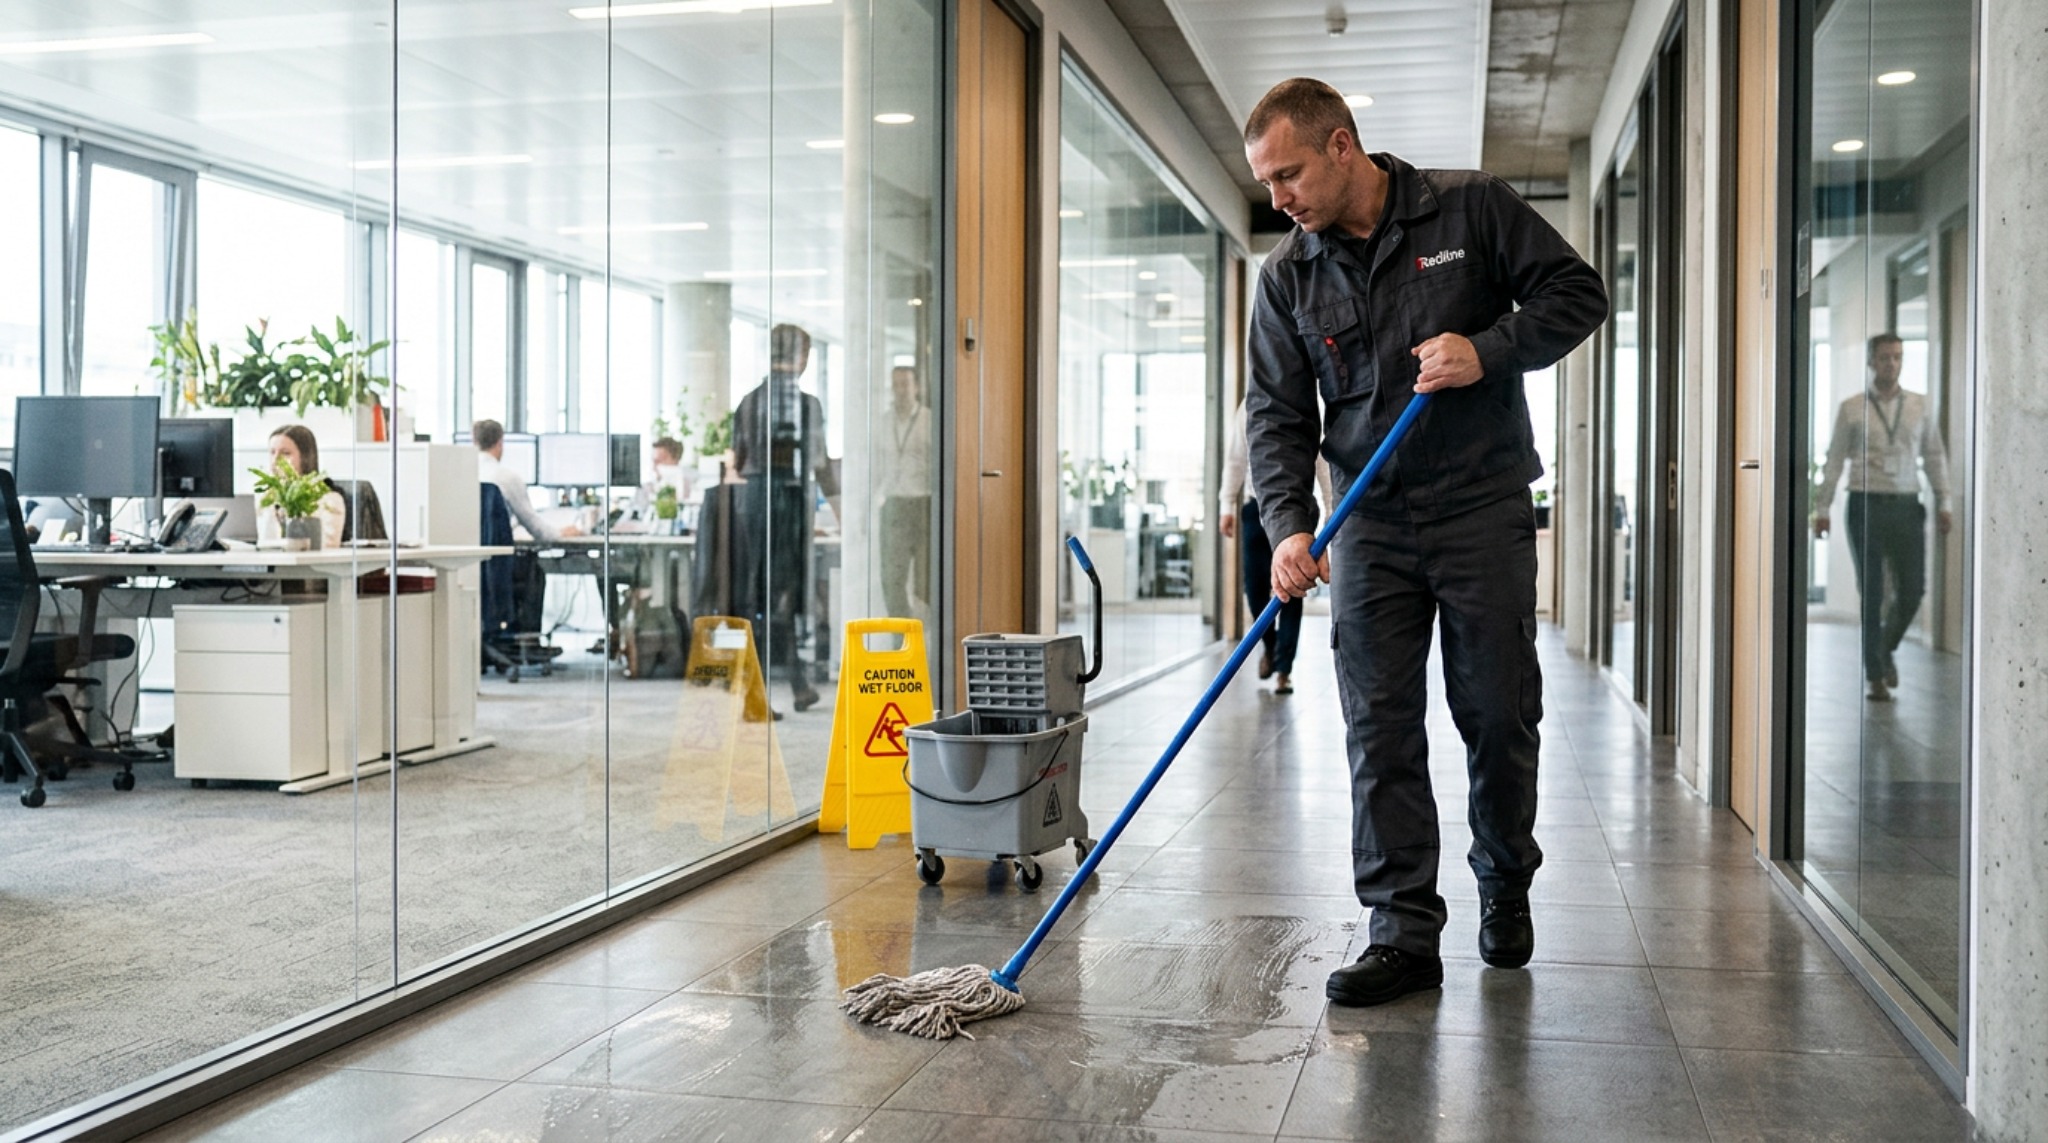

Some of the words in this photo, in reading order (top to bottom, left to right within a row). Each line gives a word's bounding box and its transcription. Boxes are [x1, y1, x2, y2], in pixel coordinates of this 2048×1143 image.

[864, 669, 915, 680] CAUTION
[859, 683, 883, 693] WET
[886, 682, 923, 693] FLOOR
